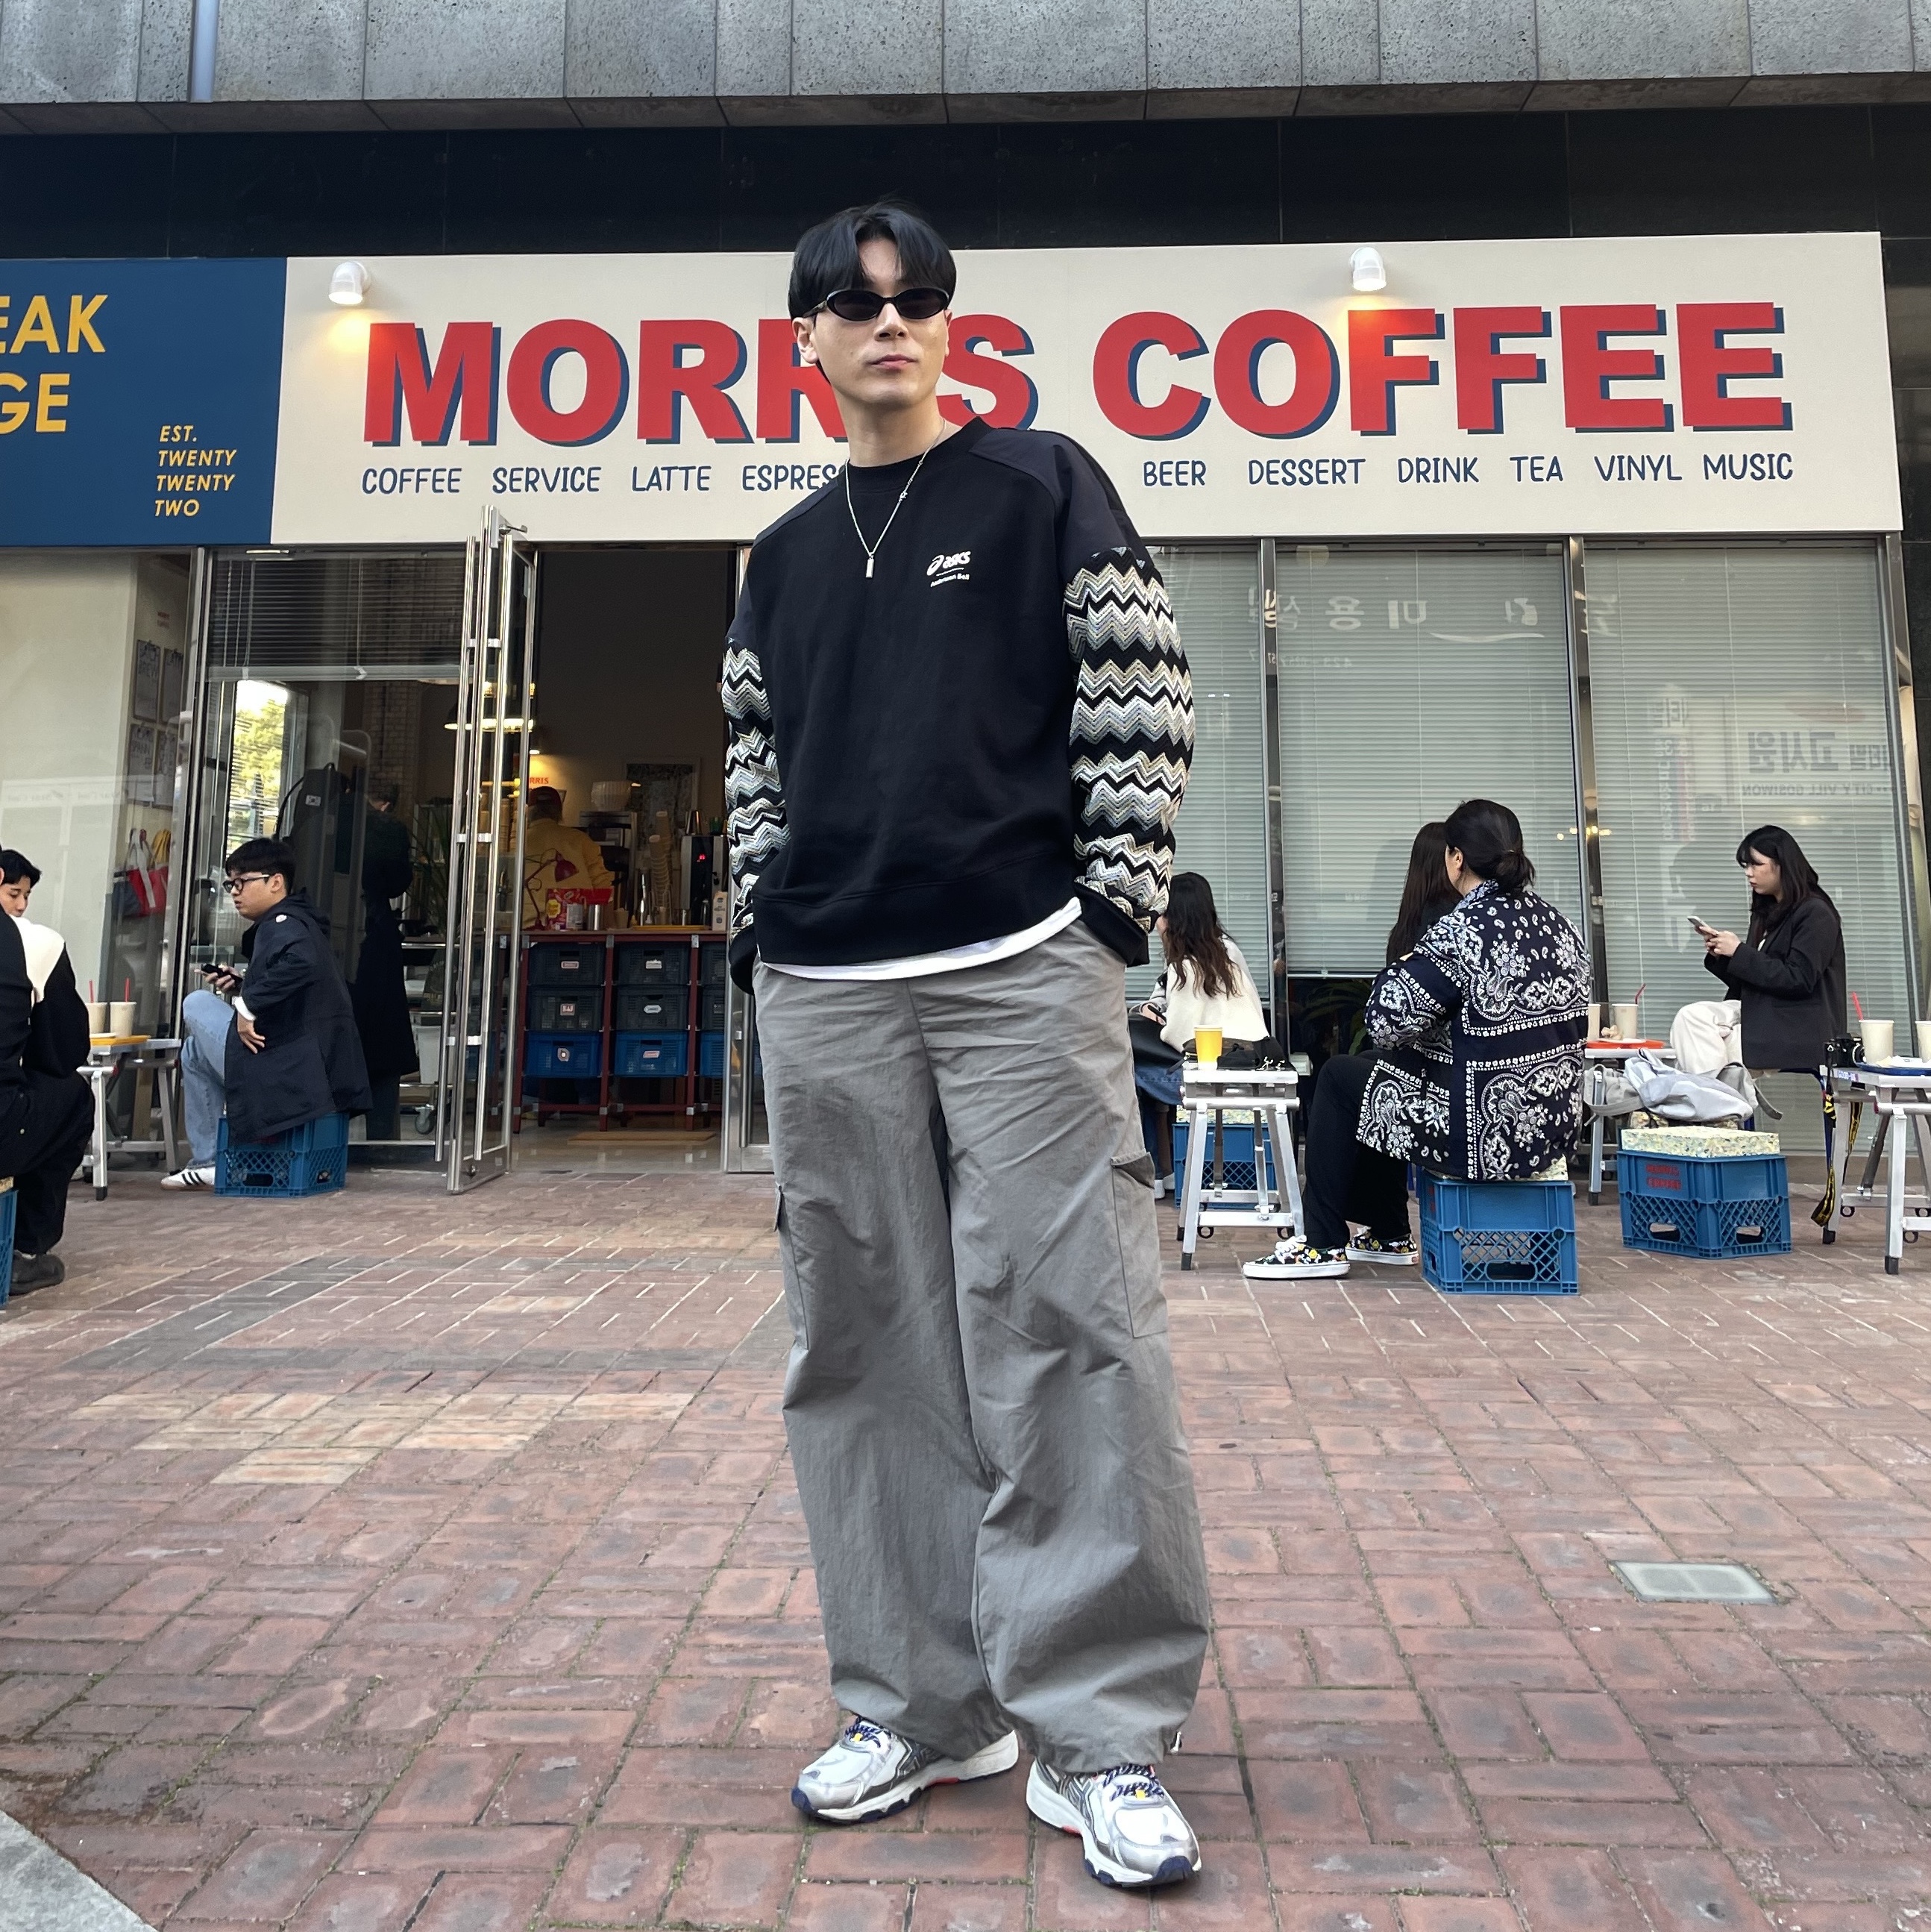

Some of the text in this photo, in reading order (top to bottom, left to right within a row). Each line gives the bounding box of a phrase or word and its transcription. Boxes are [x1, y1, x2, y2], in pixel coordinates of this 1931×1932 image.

[363, 302, 1793, 448] MORRS COFFEE
[160, 425, 198, 443] EST.
[158, 449, 237, 468] TWENTY
[156, 474, 235, 492] TWENTY
[362, 453, 1794, 495] COFFEE SERVICE LATTE ESPRES BEER DESSERT DRINK TEA VINYL MUSIC
[154, 498, 200, 517] TWO
